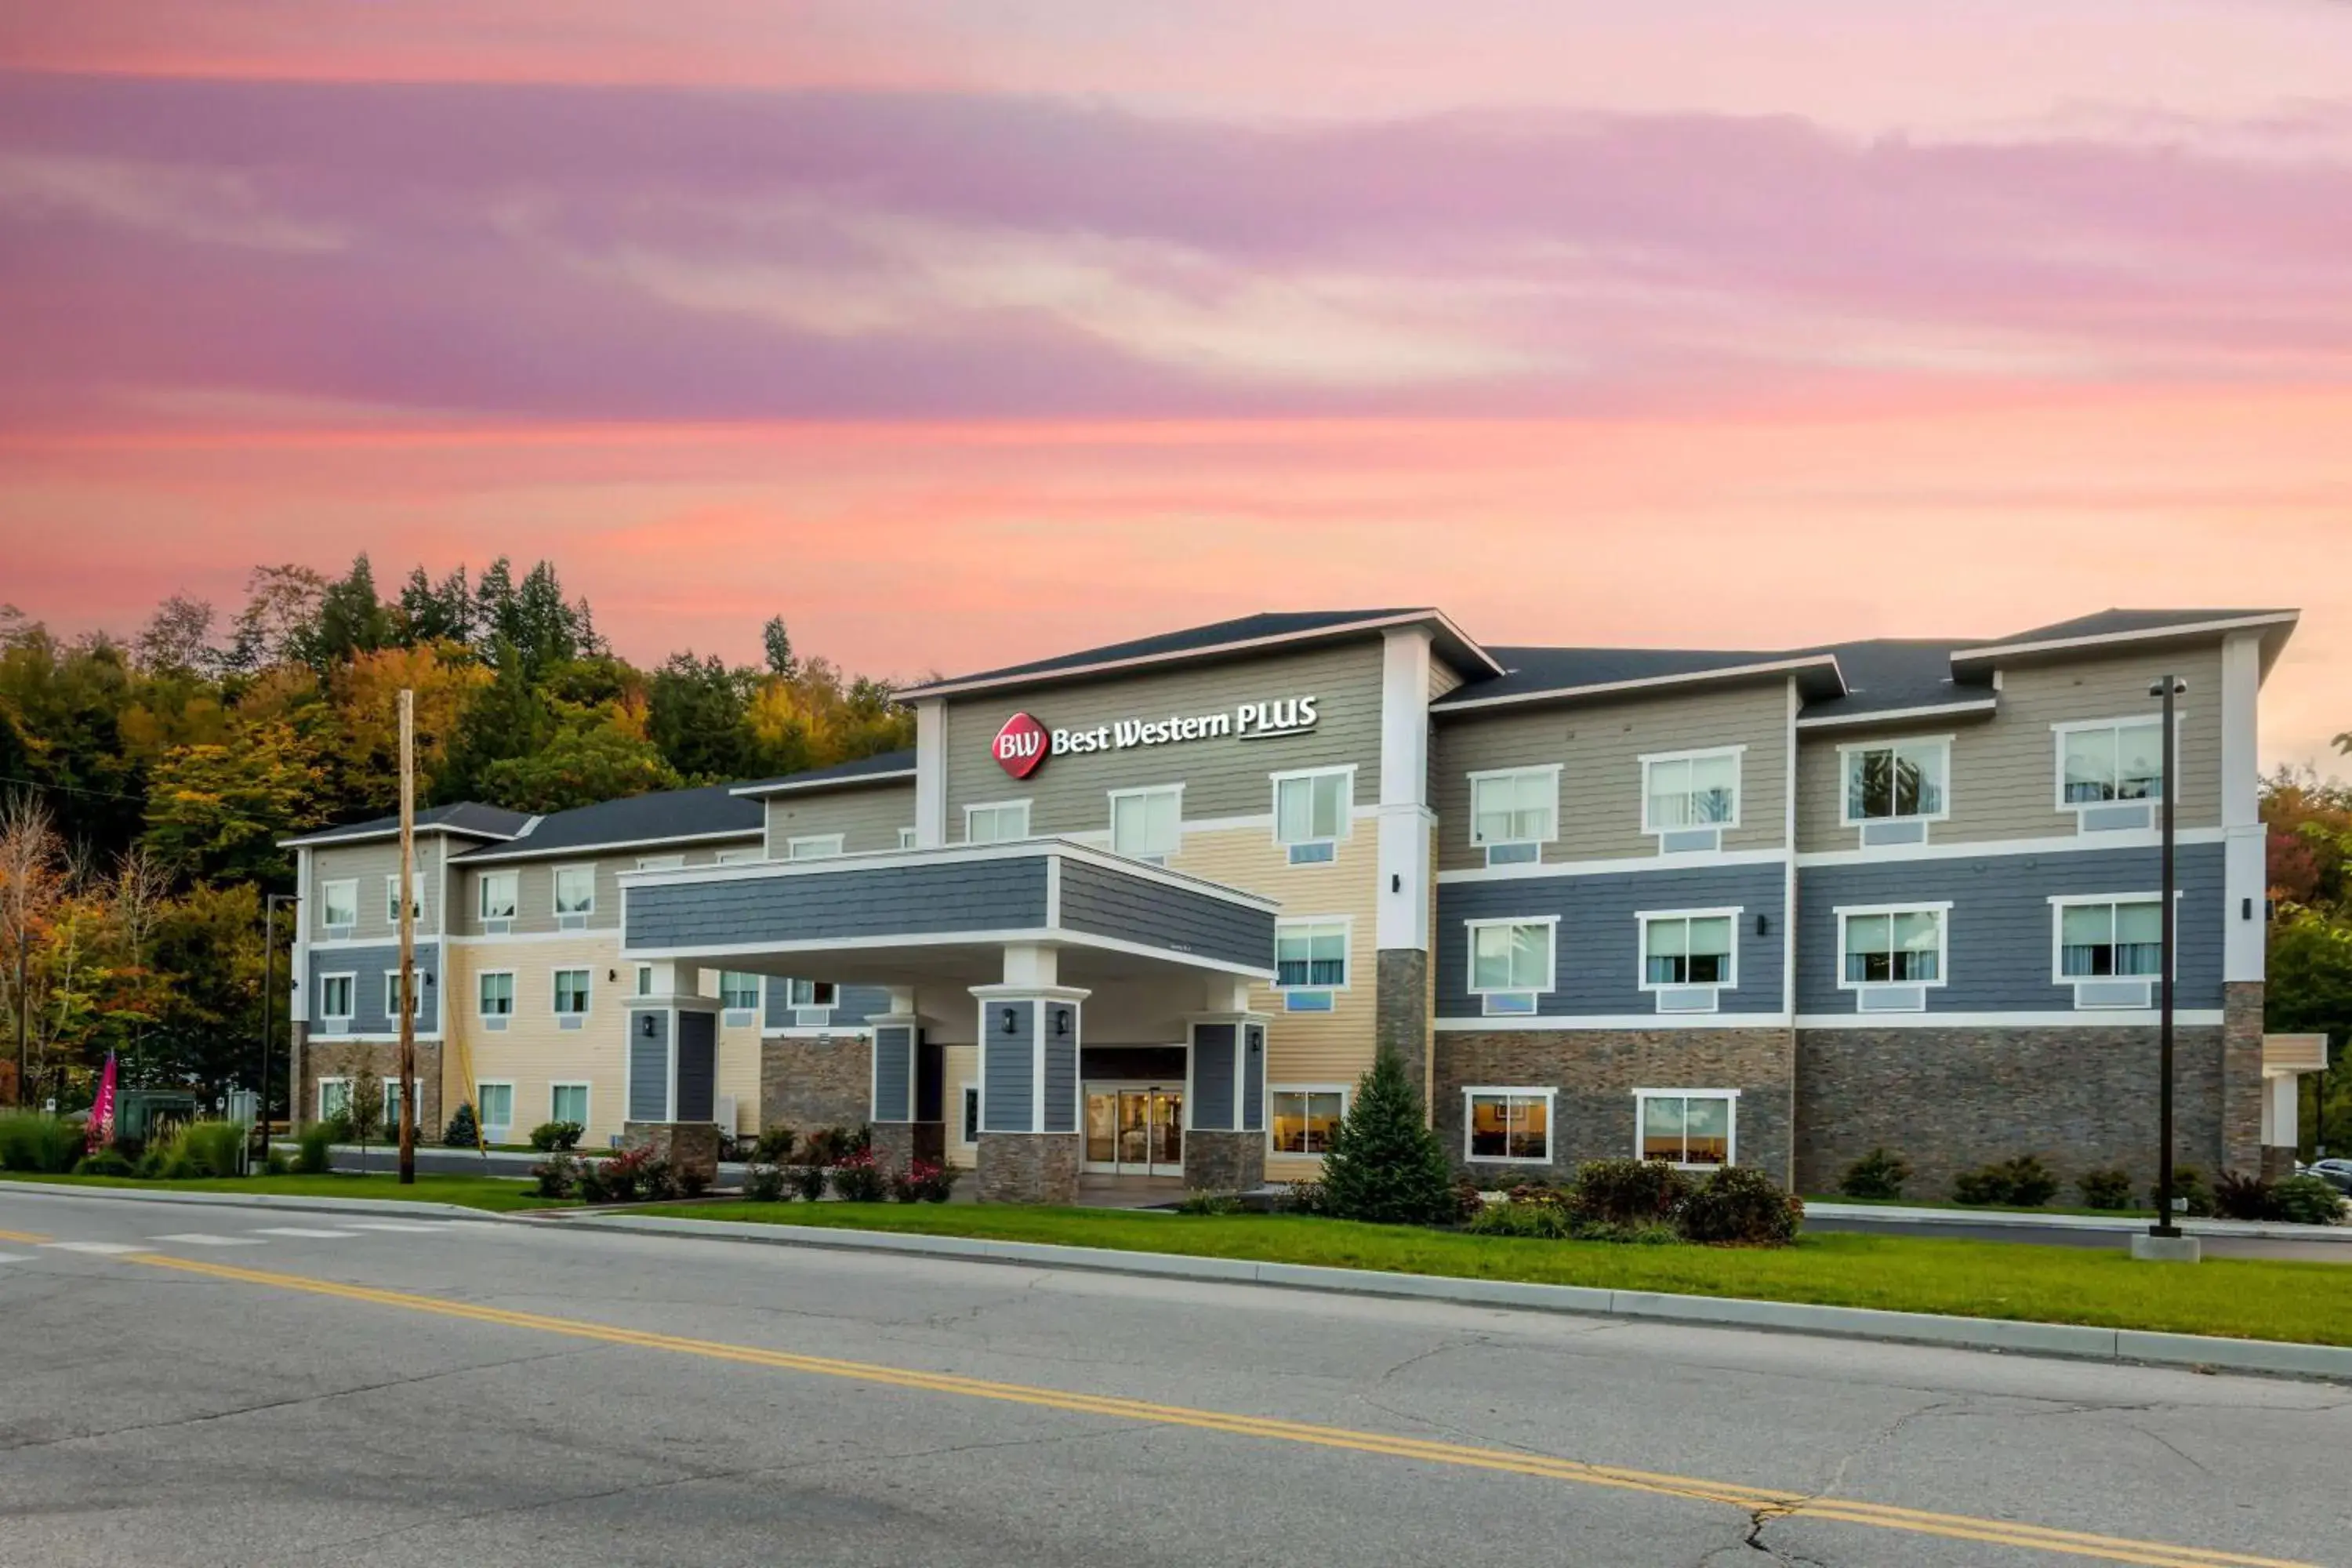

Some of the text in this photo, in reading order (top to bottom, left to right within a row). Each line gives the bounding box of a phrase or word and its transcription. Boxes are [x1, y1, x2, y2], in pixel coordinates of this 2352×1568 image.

[1000, 731, 1039, 760] BW
[1051, 695, 1317, 756] Best Western PLUS
